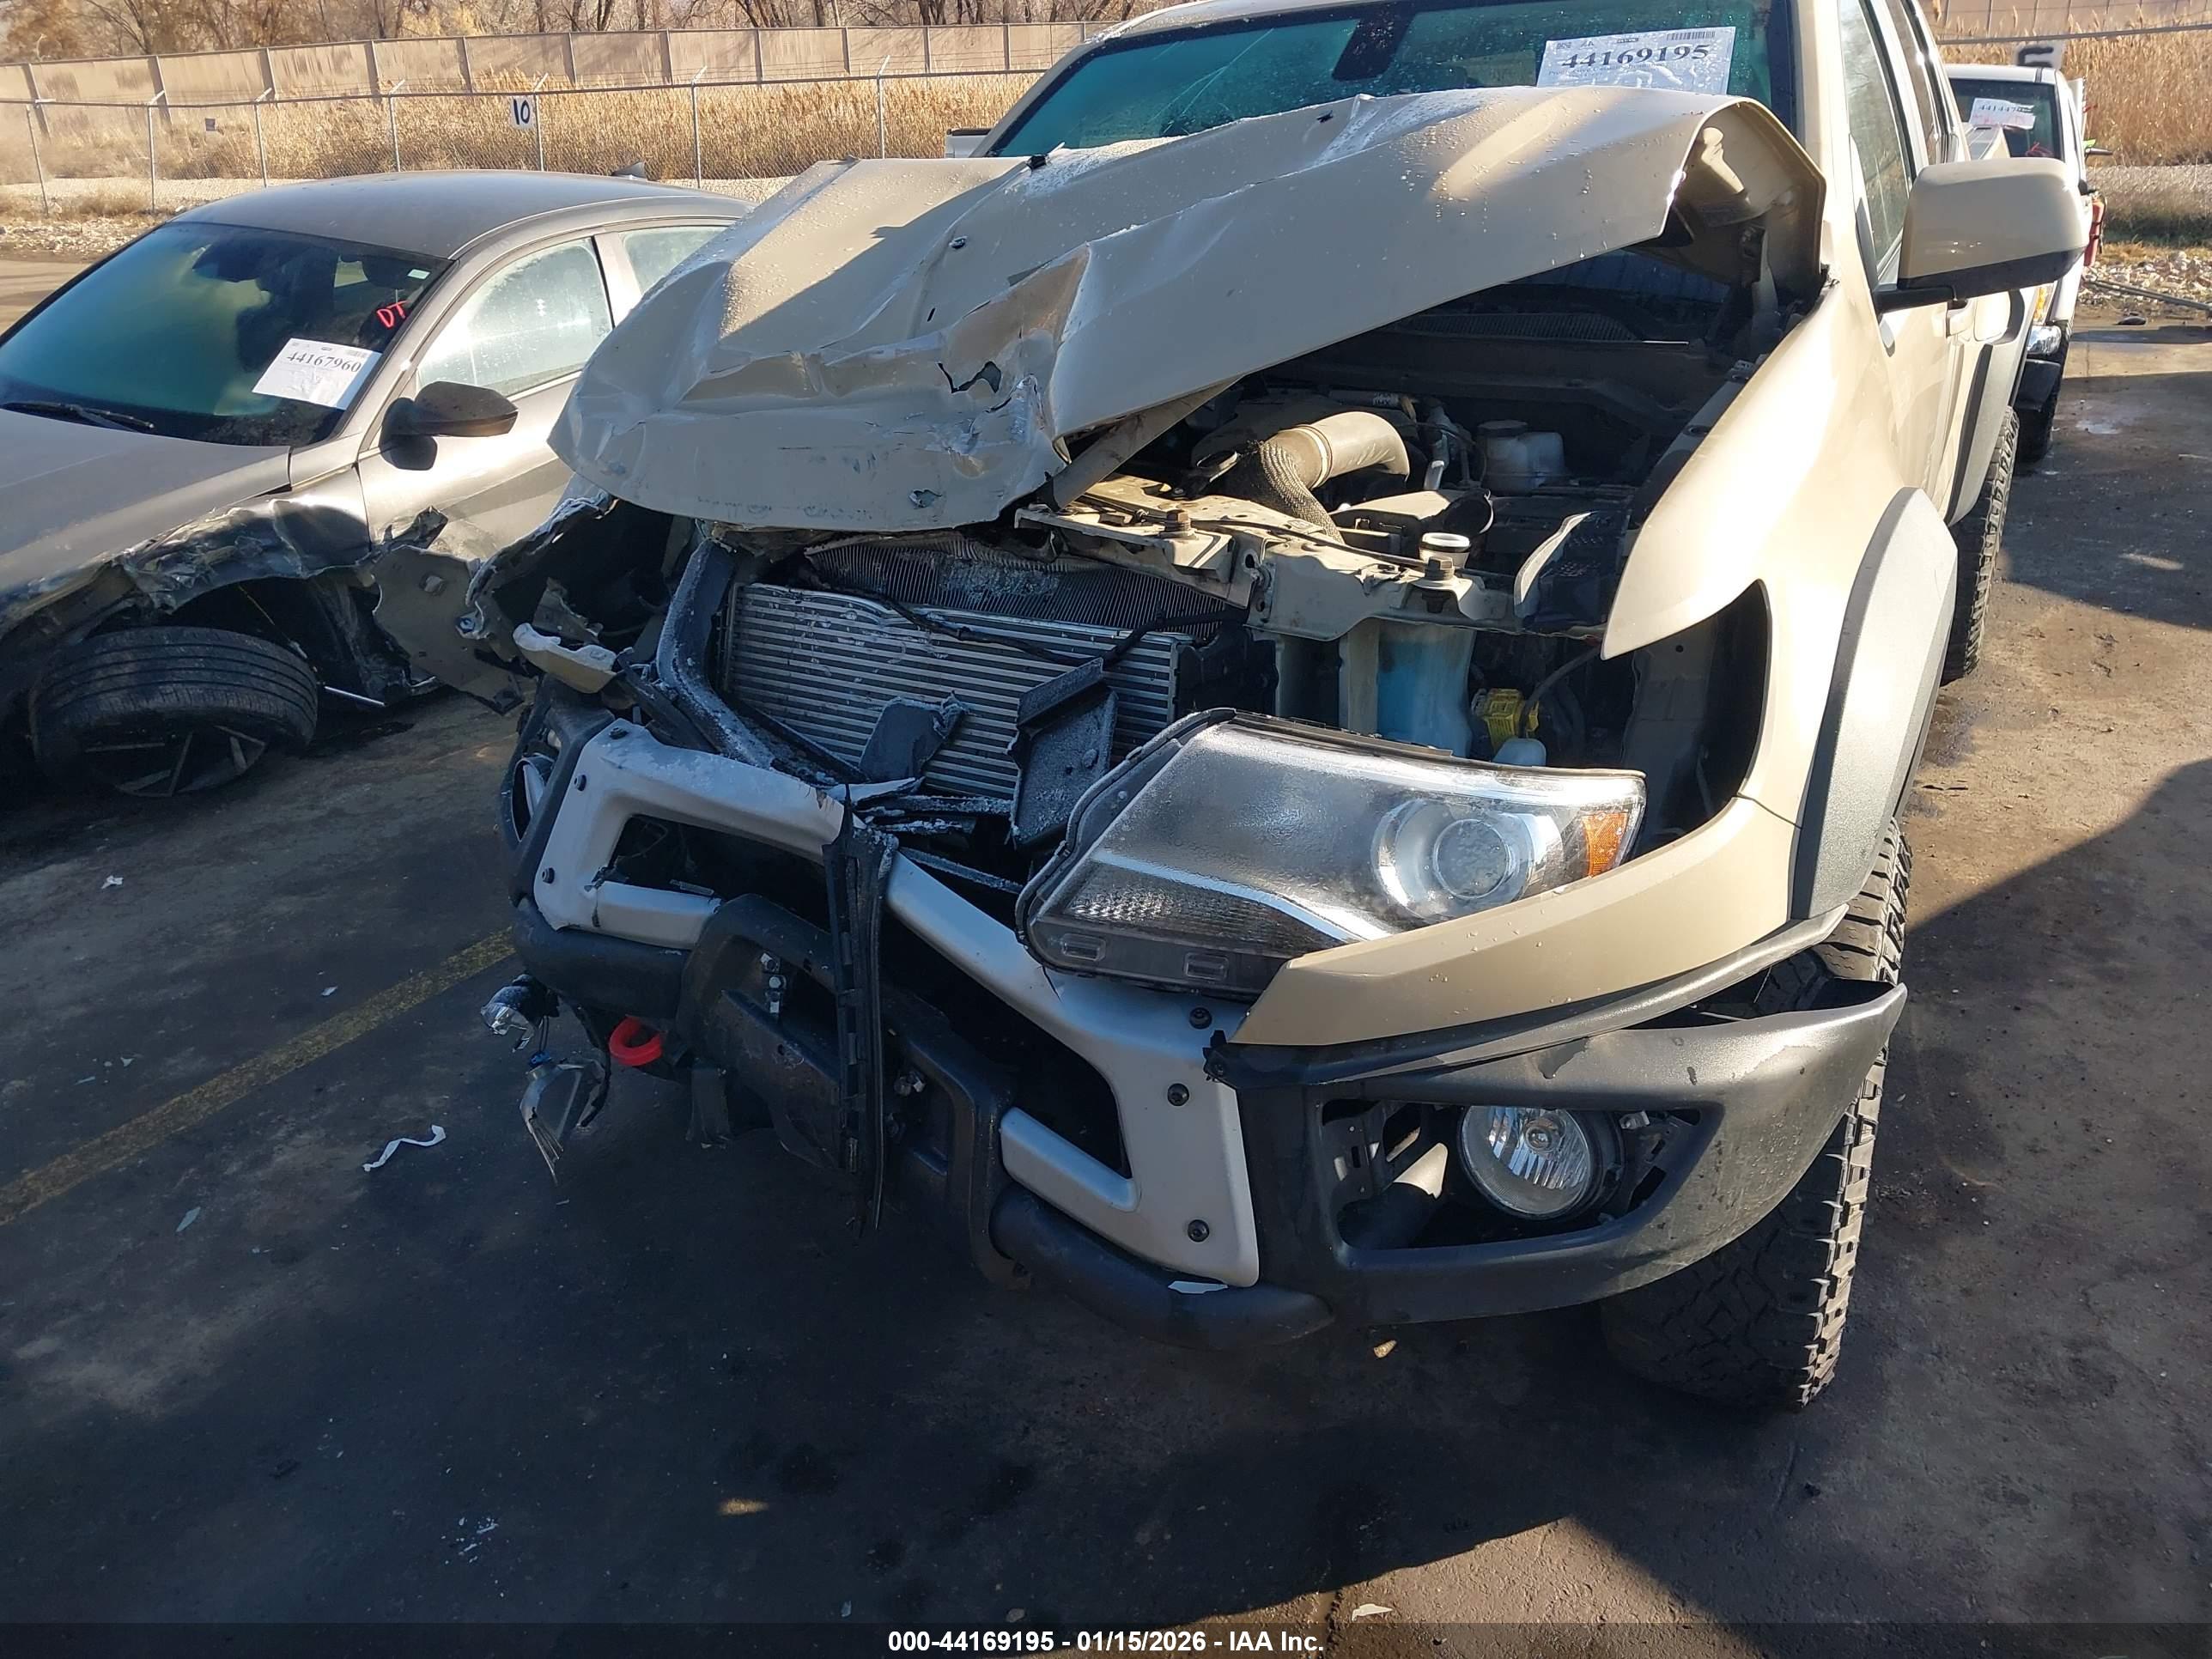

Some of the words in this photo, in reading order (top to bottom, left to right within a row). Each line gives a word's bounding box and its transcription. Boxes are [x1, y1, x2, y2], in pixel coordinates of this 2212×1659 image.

[1561, 44, 1711, 69] 44169195
[513, 99, 531, 125] 10
[376, 301, 408, 328] DT
[287, 351, 362, 374] 44167960
